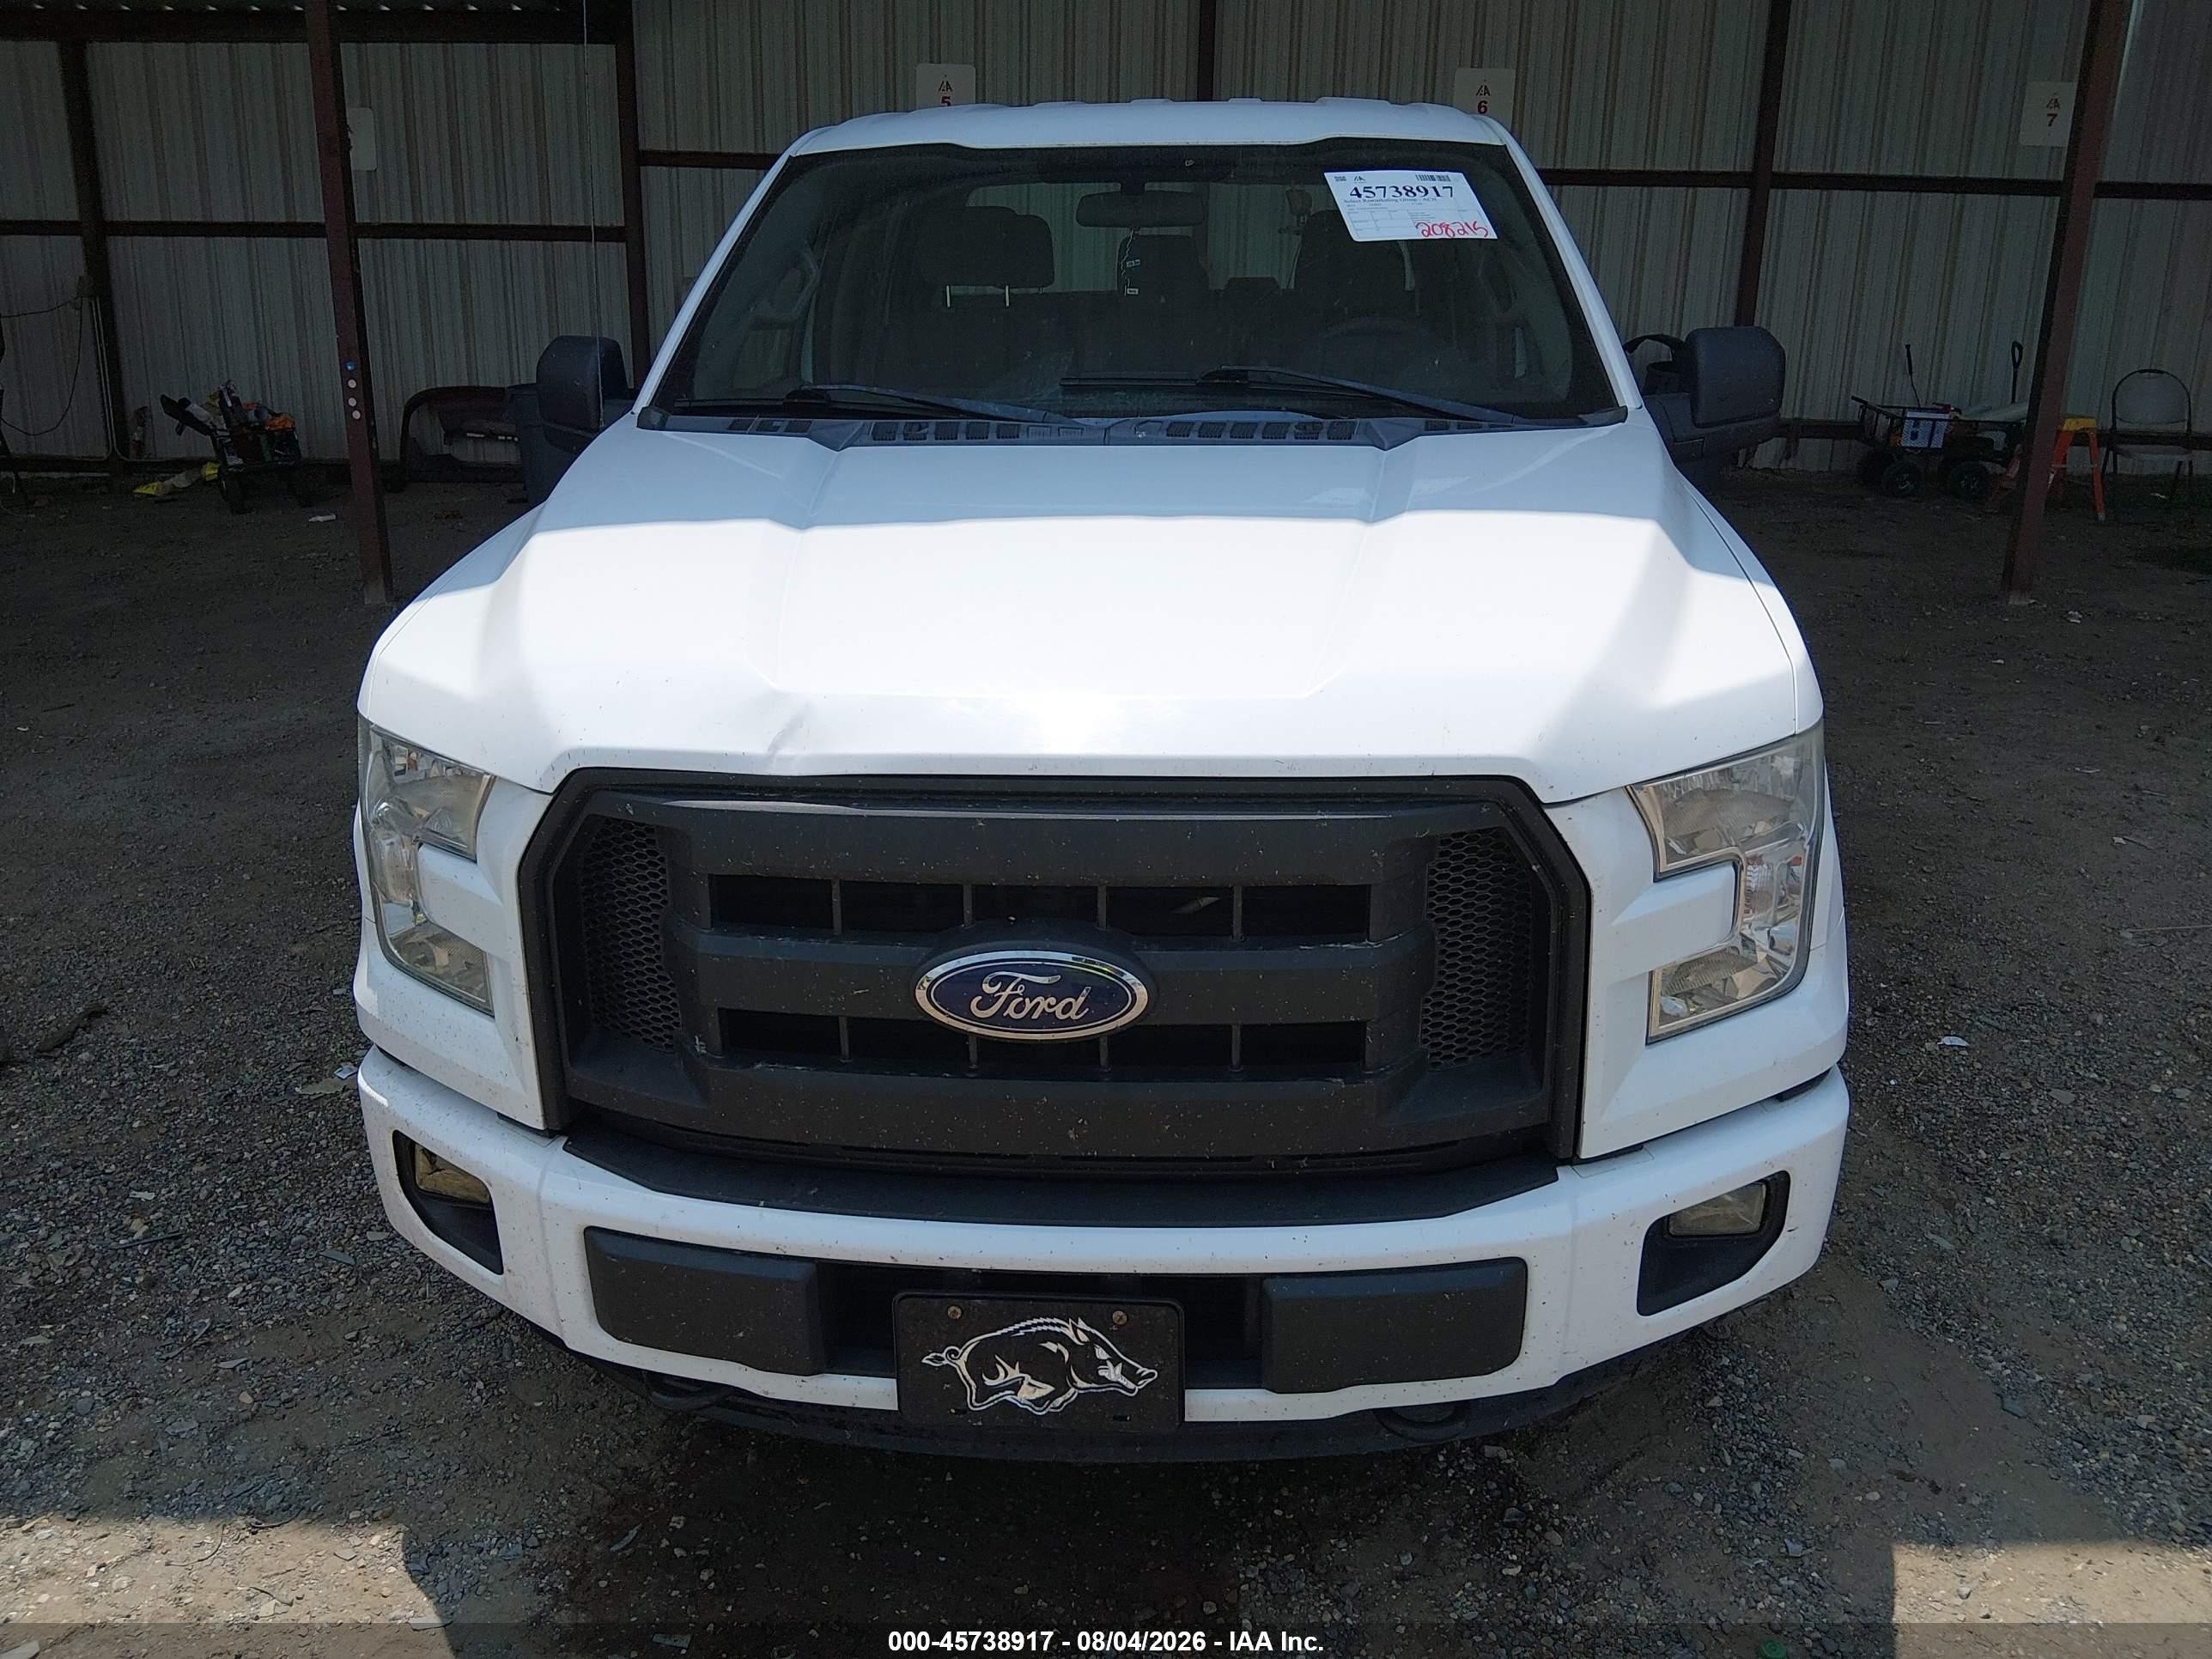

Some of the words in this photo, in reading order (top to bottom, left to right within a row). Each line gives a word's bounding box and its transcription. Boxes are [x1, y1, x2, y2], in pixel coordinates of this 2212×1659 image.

[941, 96, 951, 106] 5
[1477, 100, 1488, 114] 6
[2046, 112, 2058, 127] 7
[1349, 185, 1455, 199] 45738917
[969, 970, 1092, 1021] Ford
